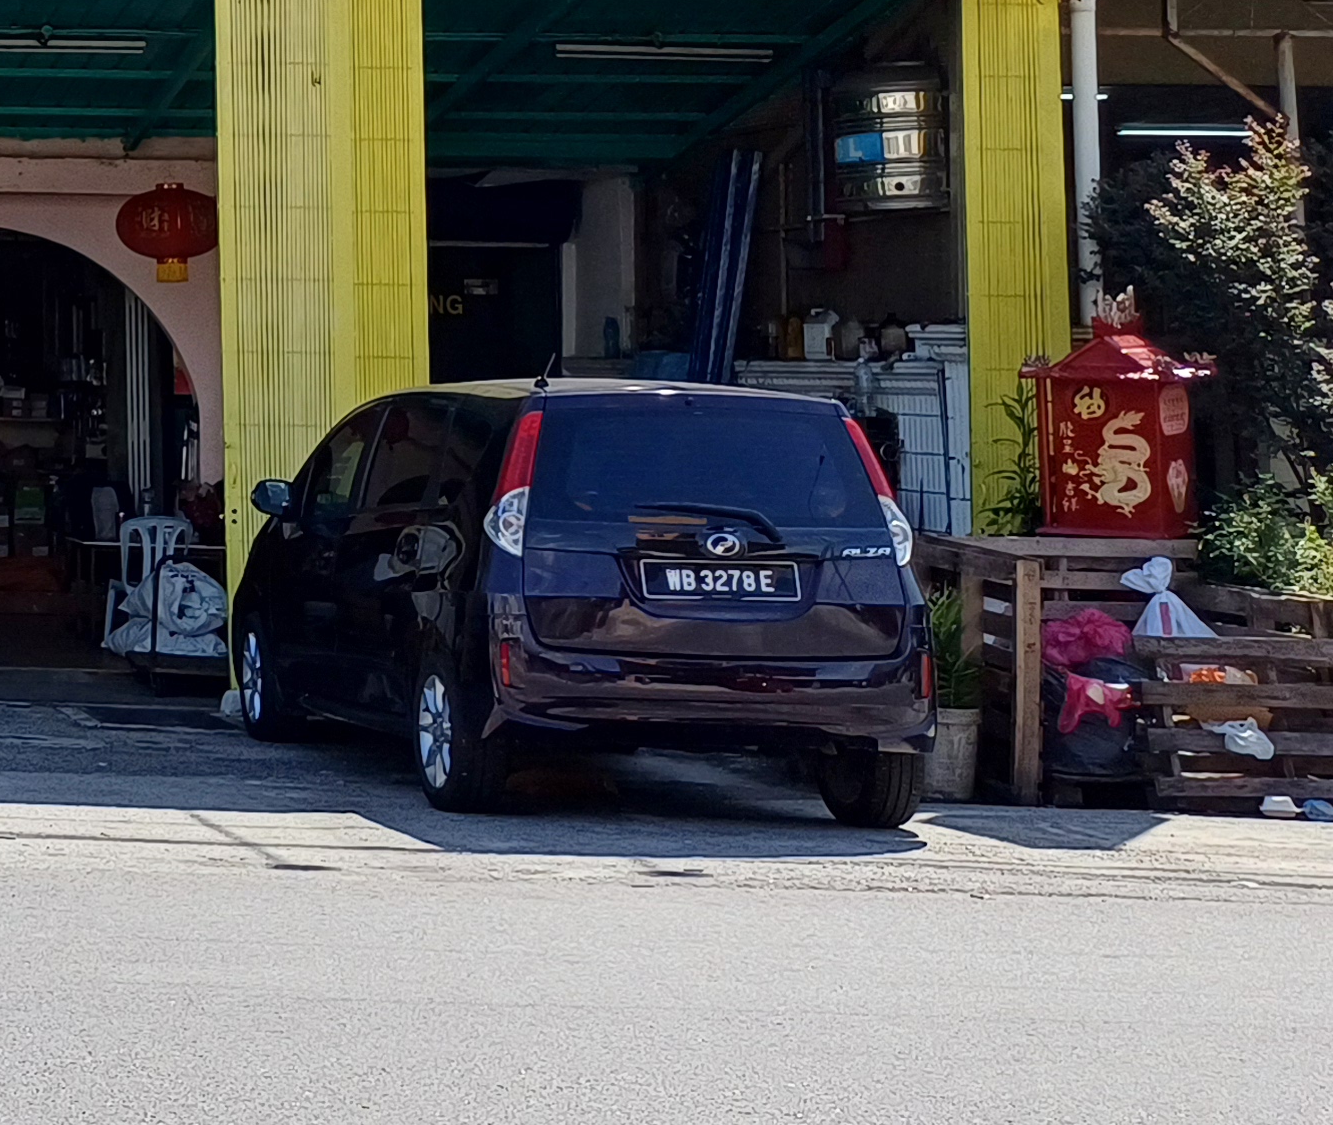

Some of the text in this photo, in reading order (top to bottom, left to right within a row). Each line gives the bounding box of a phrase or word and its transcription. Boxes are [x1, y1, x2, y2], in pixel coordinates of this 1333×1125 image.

[665, 568, 775, 592] WB 3278 E
